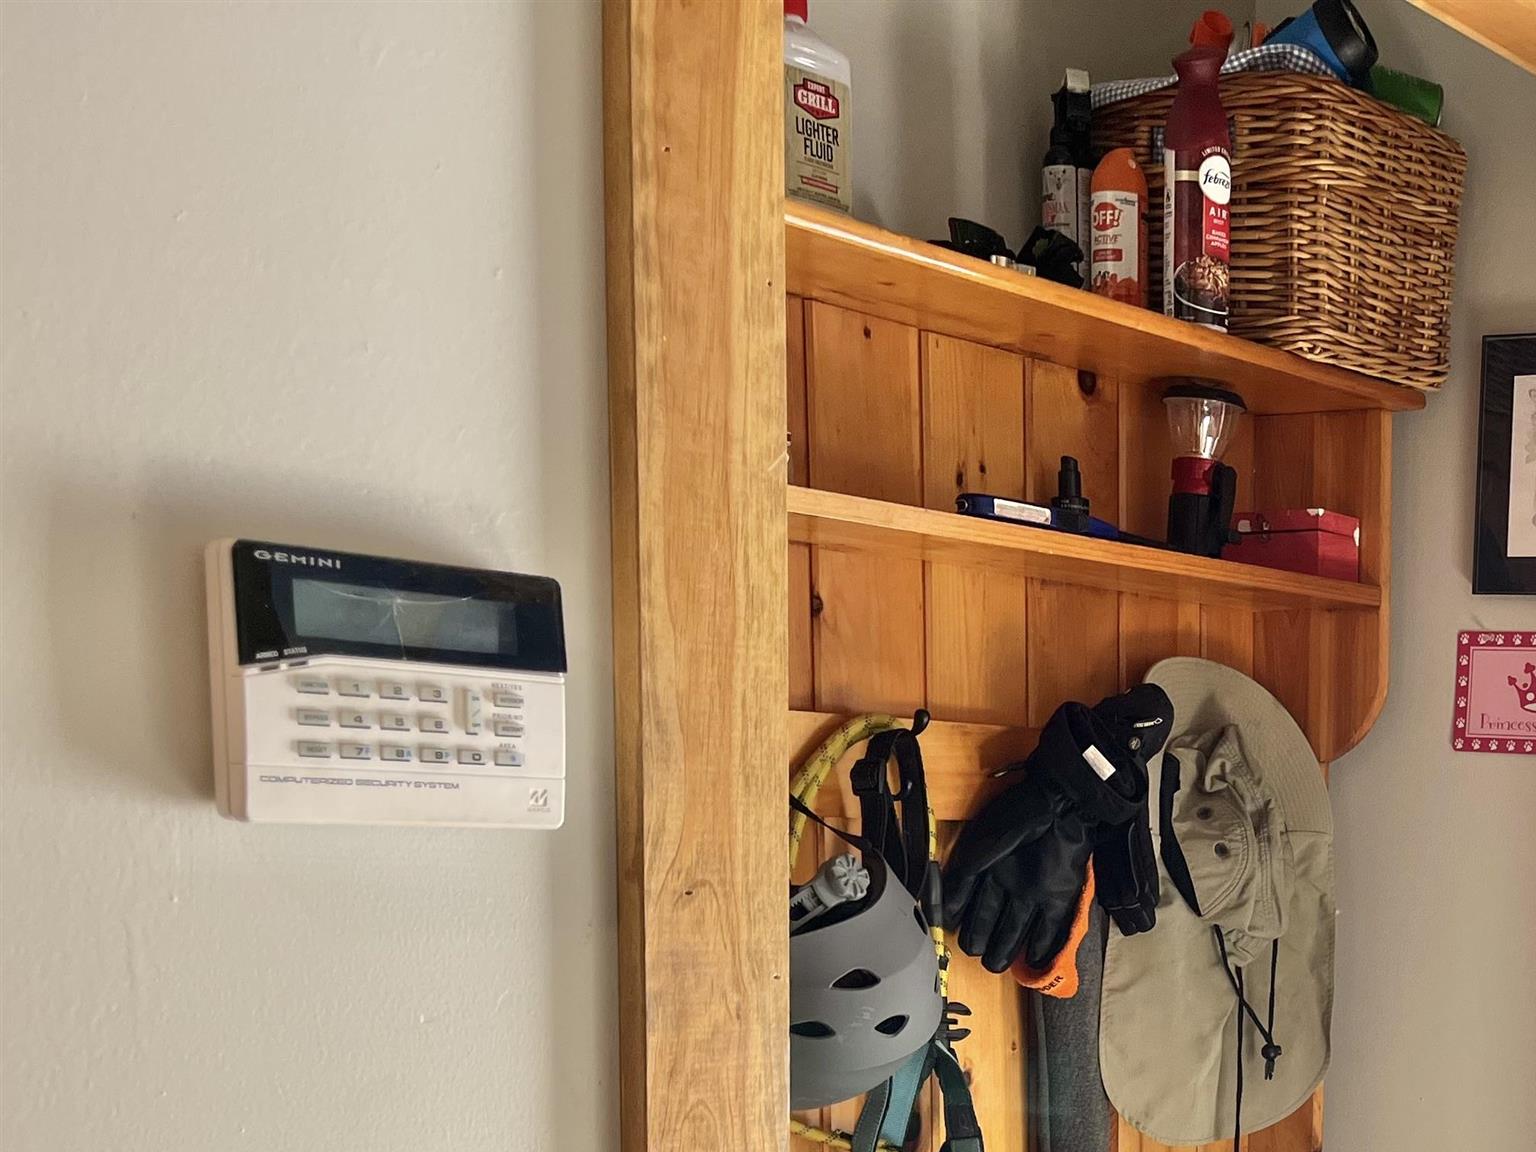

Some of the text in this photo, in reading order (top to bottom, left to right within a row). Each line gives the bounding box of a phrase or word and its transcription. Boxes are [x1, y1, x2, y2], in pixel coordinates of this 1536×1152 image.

[797, 89, 836, 114] GRILL
[796, 116, 839, 147] LIGHTER
[804, 137, 834, 163] FLUID
[1209, 206, 1228, 220] AIR
[254, 549, 341, 570] GEMINI
[393, 686, 402, 695] 2
[432, 689, 442, 698] 3
[353, 715, 363, 723] 4
[394, 717, 404, 726] 5
[434, 720, 443, 729] 6
[395, 749, 405, 758] 8
[434, 751, 443, 760] 9
[471, 752, 482, 761] 0
[259, 775, 460, 790] COMPUTERIZED SECURITY SYSTEM
